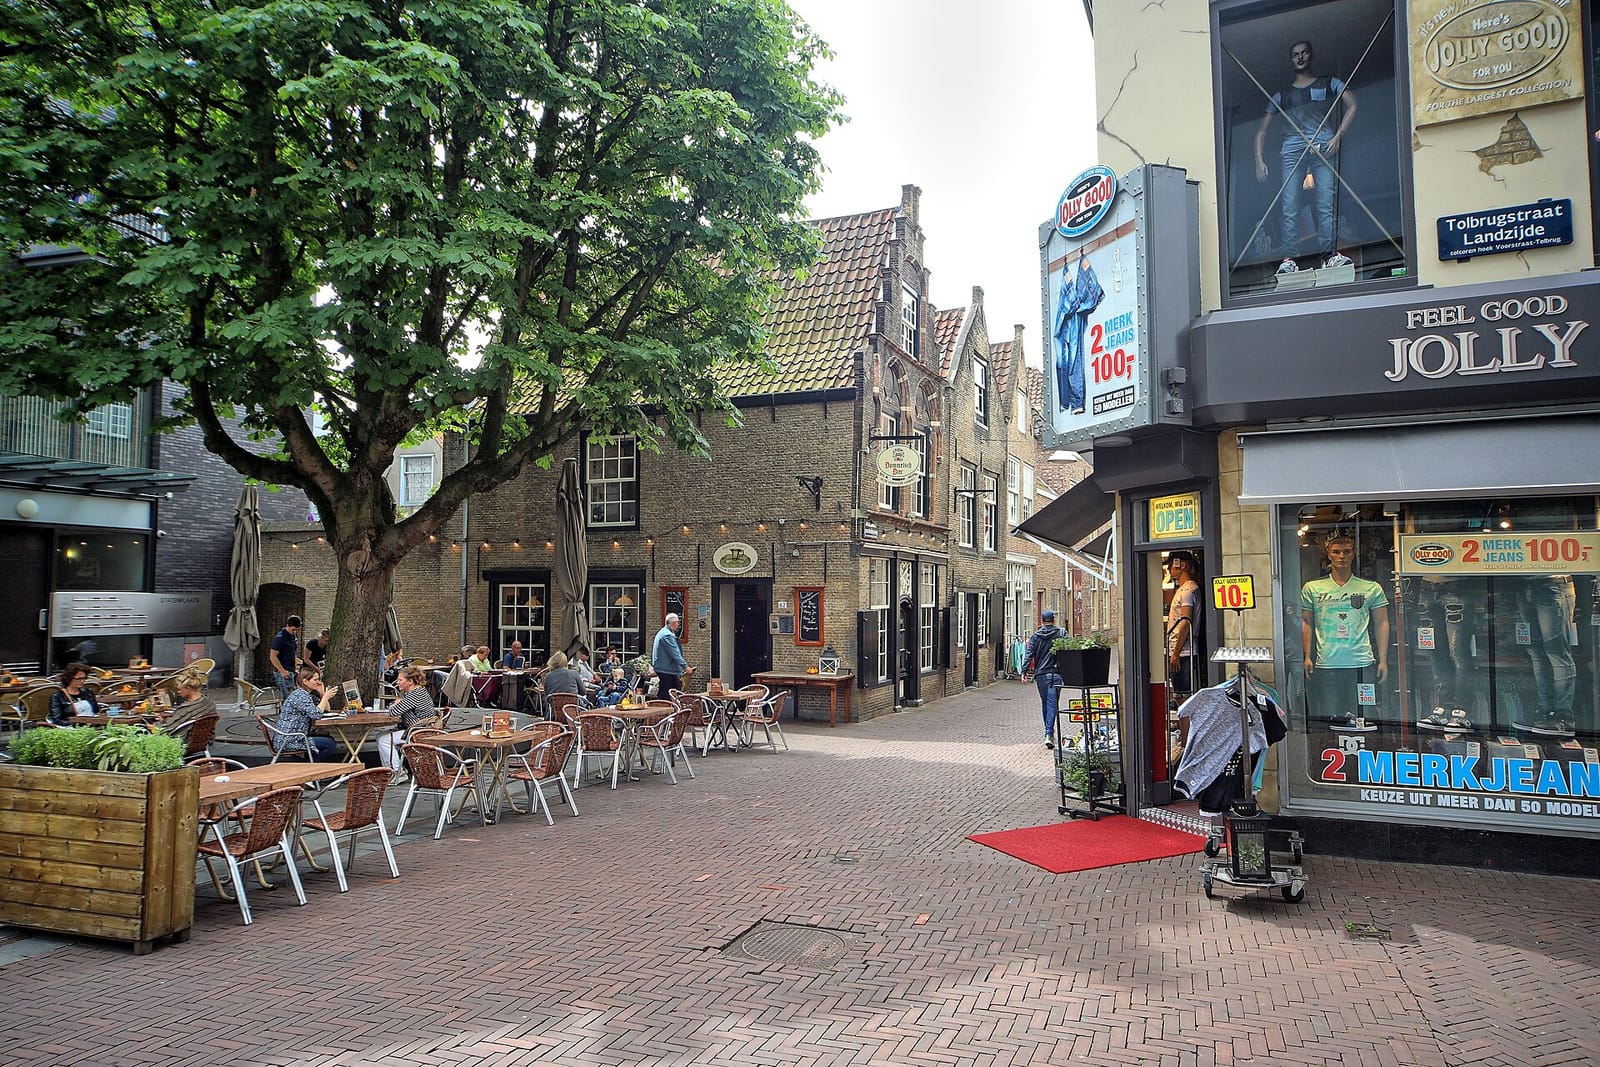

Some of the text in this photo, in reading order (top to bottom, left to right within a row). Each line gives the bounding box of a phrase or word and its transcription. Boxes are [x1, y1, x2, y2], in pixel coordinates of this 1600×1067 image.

[1472, 14, 1511, 32] Here's
[1432, 14, 1563, 73] JOLLY GOOD
[1472, 62, 1514, 78] FOR YOU
[1426, 78, 1572, 112] FOR THE LARGEST COLLECTION
[1058, 197, 1081, 228] JOLLY
[1085, 176, 1112, 207] GOOD
[1446, 204, 1563, 232] Tolbrugstraat
[1464, 224, 1545, 246] Landzijde
[1406, 296, 1568, 330] FEEL GOOD
[1090, 311, 1132, 355] 2 MERK
[1105, 328, 1135, 350] JEANS
[1384, 320, 1590, 382] JOLLY
[1094, 404, 1102, 414] 50
[1156, 508, 1194, 532] OPEN
[1412, 550, 1453, 560] JOLLY GOOD
[1462, 540, 1480, 563] 2
[1482, 539, 1521, 550] MERK
[1482, 552, 1524, 563] JEANS
[1322, 748, 1346, 781] 2
[1360, 789, 1600, 817] KEUZE UIT MEER DAN 50 MODEL
